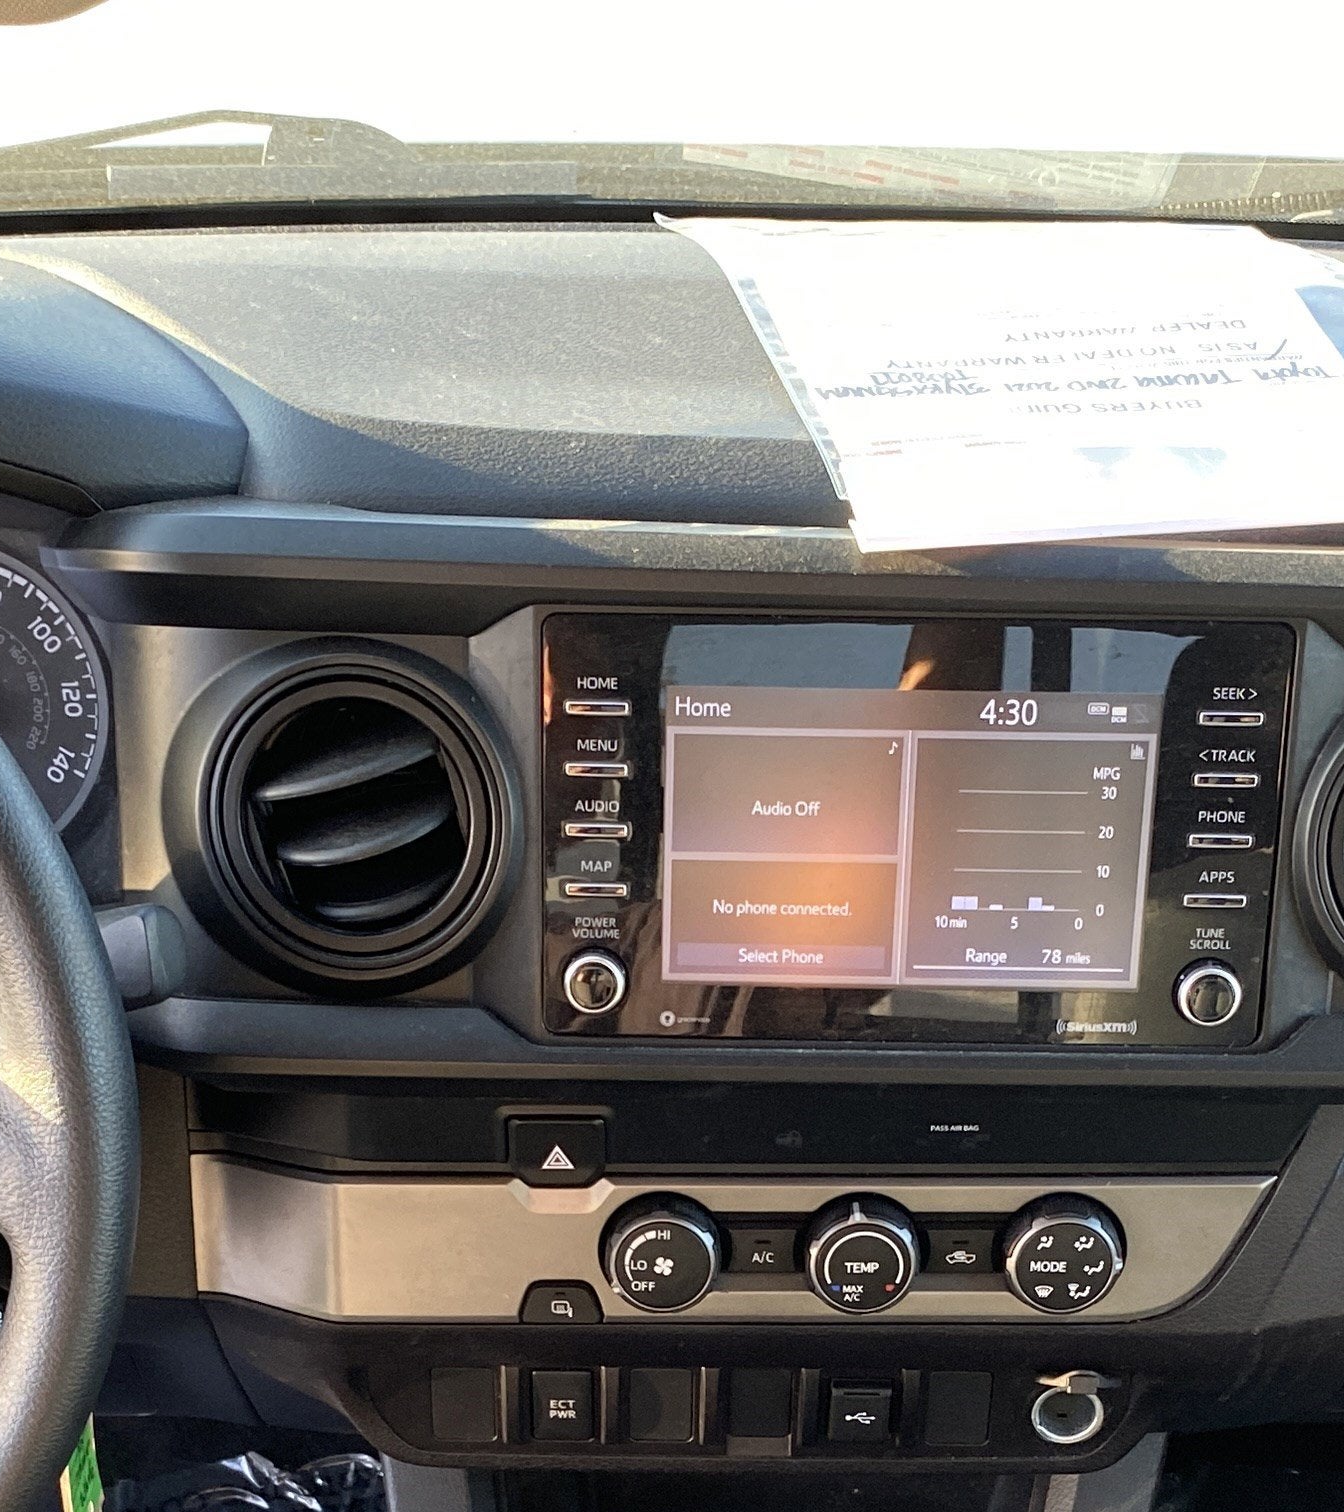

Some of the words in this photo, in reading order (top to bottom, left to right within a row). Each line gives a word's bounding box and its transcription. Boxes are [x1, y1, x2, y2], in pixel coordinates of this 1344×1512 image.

[27, 616, 62, 653] 100
[577, 677, 618, 690] HOME
[60, 680, 83, 717] 120
[675, 696, 731, 717] Home
[980, 699, 1038, 726] 4:30
[577, 739, 618, 752] MENU
[46, 746, 75, 784] 140
[1093, 767, 1121, 781] MPG
[1101, 787, 1117, 800] 30
[575, 800, 620, 813] AUDIO
[752, 801, 791, 816] Audio
[795, 801, 820, 817] Off
[1198, 810, 1246, 823] PHONE
[1098, 826, 1114, 839] 20
[581, 860, 612, 873] MAP
[1096, 866, 1110, 878] 10
[1199, 871, 1235, 883] APPS
[713, 899, 733, 914] No
[736, 901, 777, 917] phone
[780, 902, 853, 917] connected.
[1096, 904, 1105, 917] 0
[575, 916, 616, 928] POWER
[935, 915, 949, 929] 10
[949, 917, 967, 929] min
[1010, 916, 1019, 929] 5
[1074, 917, 1083, 930] 0
[572, 928, 620, 939] VOLUME
[1195, 928, 1225, 939] TUNE
[1189, 939, 1231, 950] SCROLL
[738, 947, 777, 966] Select
[781, 948, 824, 966] Phone
[965, 948, 1007, 965] Range
[1041, 949, 1061, 964] 78
[1065, 951, 1091, 965] miles
[657, 1230, 671, 1241] HI
[752, 1251, 774, 1264] A/C
[630, 1260, 647, 1271] LO
[844, 1262, 880, 1273] TEMP
[1029, 1259, 1067, 1273] MODE
[631, 1281, 656, 1292] OFF
[843, 1284, 863, 1293] MAX
[843, 1293, 860, 1302] A/C
[550, 1398, 576, 1409] ECT
[549, 1409, 577, 1421] PWR
